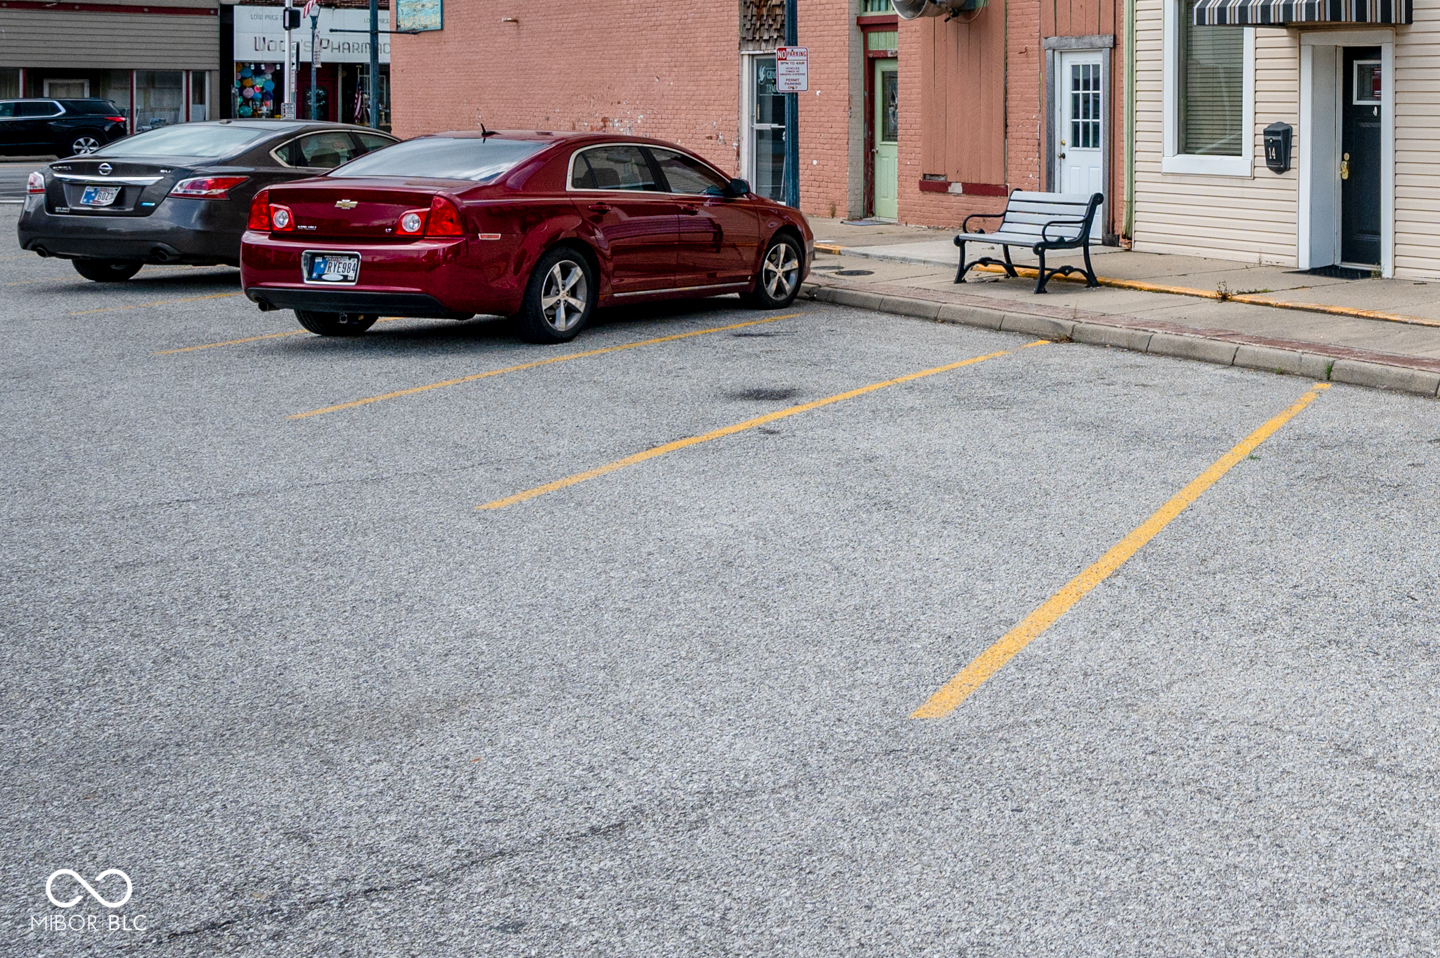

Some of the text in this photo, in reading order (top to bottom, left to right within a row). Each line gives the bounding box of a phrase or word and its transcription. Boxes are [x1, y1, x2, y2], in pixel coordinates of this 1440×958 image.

[777, 50, 787, 59] NO
[1268, 147, 1276, 160] 14
[326, 261, 357, 275] RYE984
